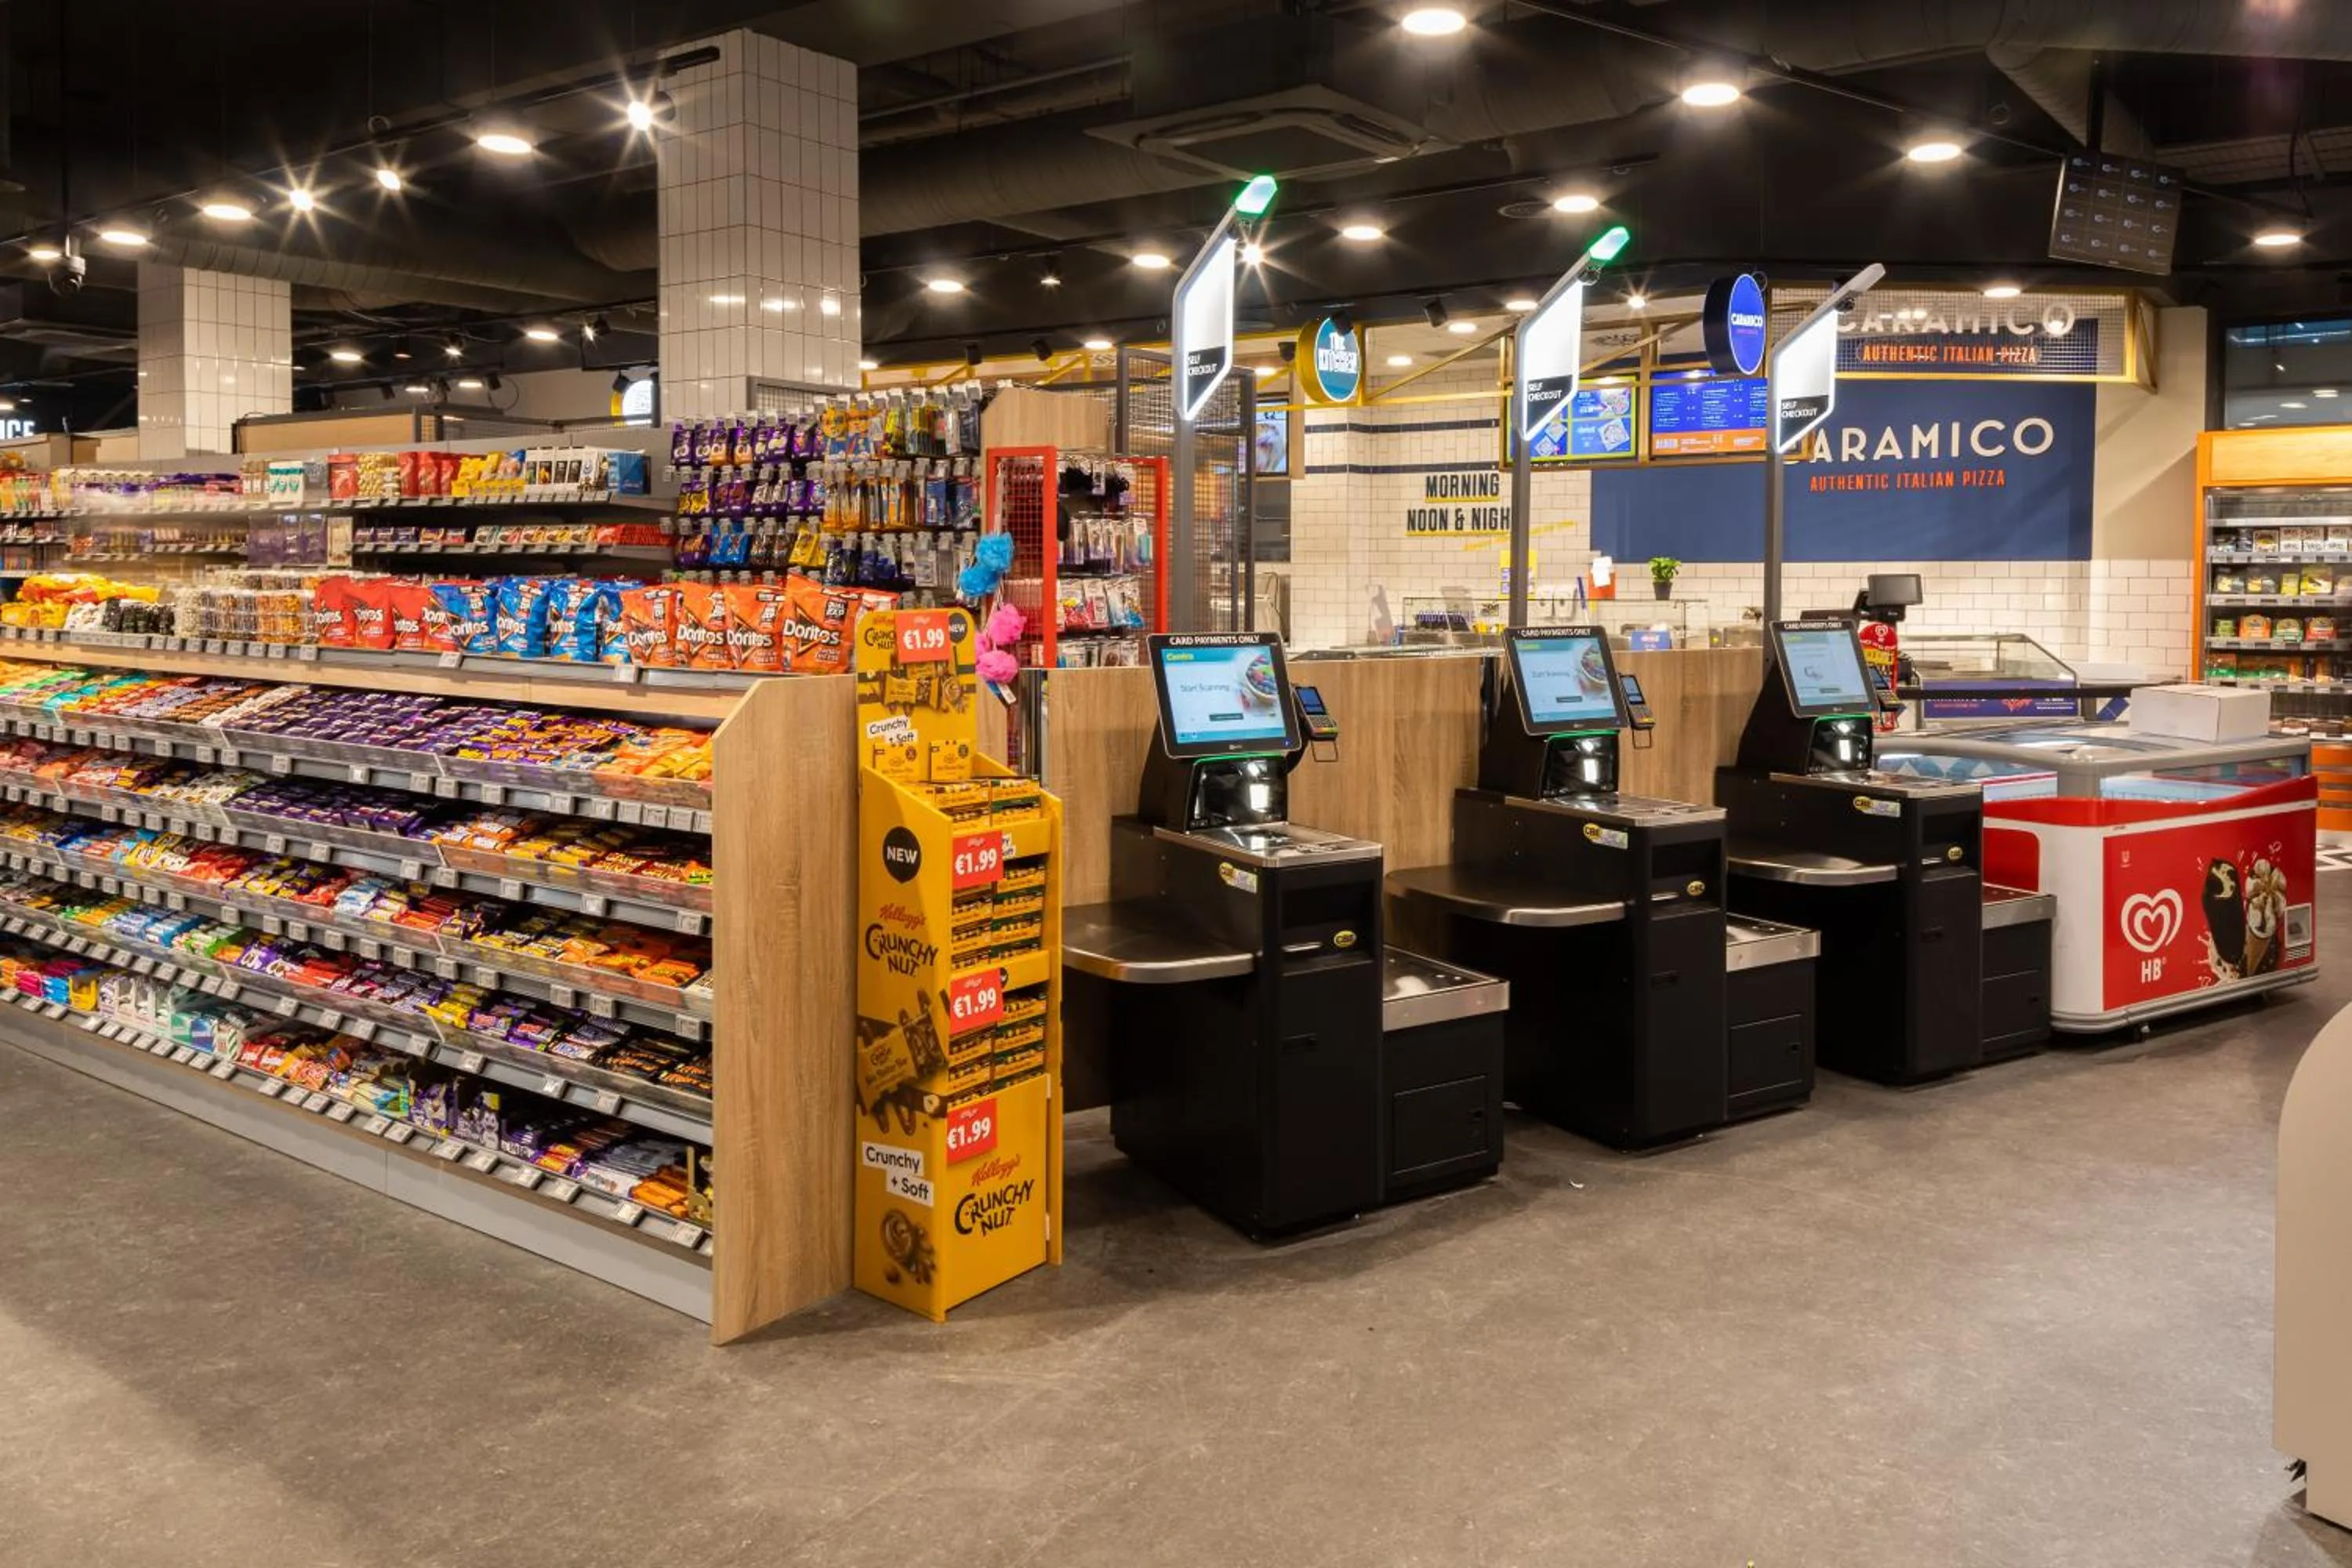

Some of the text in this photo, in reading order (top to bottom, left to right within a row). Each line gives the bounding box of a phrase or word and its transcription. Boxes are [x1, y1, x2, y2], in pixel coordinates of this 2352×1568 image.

[1188, 354, 1200, 364] SELF
[1863, 344, 2036, 364] AUTHENTIC ITALIAN PIZZA
[1188, 364, 1218, 376] CHECKOUT
[1528, 382, 1544, 391] SELF
[1528, 390, 1563, 401] CHECKOUT
[1781, 401, 1798, 410] SELF
[1781, 408, 1817, 419] CHECKOUT
[1783, 418, 2055, 465] ARAMICO
[1425, 473, 1500, 498] MORNING
[1810, 469, 2005, 492] AUTHENTIC ITALIAN PIZZA
[1406, 507, 1511, 532] NOON & NIGH
[452, 619, 490, 636] oritos
[628, 628, 667, 645] Doritos
[677, 625, 724, 645] Doritos
[727, 628, 773, 647] Doritos
[785, 619, 841, 645] Doritos
[903, 629, 945, 650] €1.99
[1169, 634, 1260, 645] CARD PAYMENTS ONLY
[869, 717, 909, 735] Crunchy
[897, 732, 914, 742] Soft
[887, 846, 917, 865] NEW
[955, 848, 997, 875] €1.99
[879, 903, 926, 930] Kellogg's
[865, 923, 938, 967] CRUNCHY
[887, 956, 920, 978] NUT
[2141, 958, 2161, 984] HB
[953, 987, 997, 1018] €1.99
[947, 1117, 991, 1150] €1.99
[866, 1146, 920, 1174] Crunchy
[971, 1154, 1022, 1186] Kellogg's
[901, 1178, 929, 1200] Soft
[954, 1178, 1035, 1236] CRUNCHY
[981, 1207, 1015, 1236] NUT
